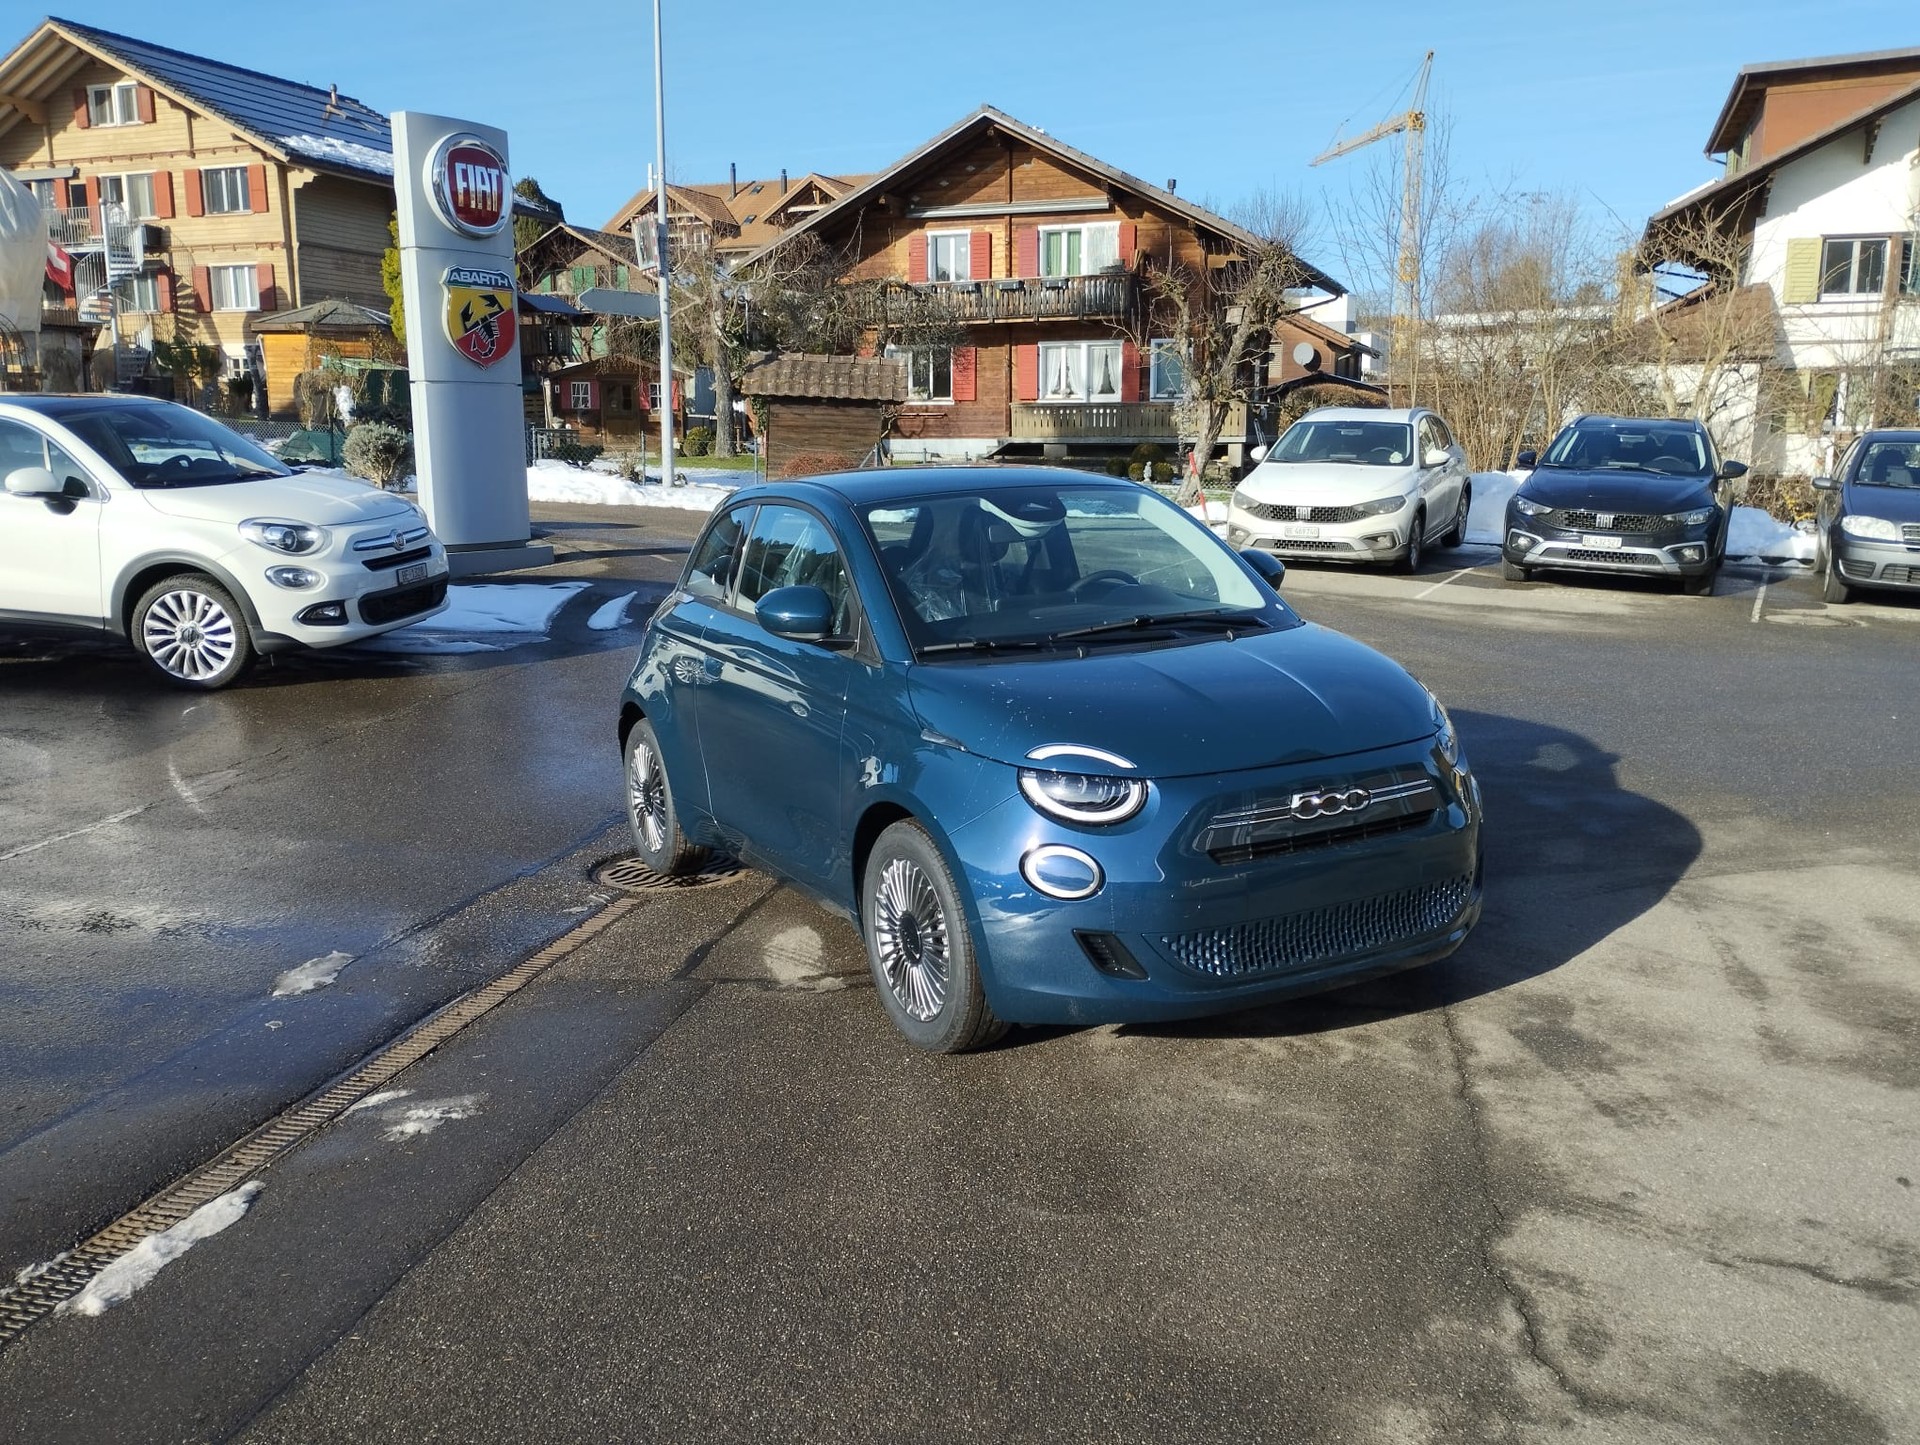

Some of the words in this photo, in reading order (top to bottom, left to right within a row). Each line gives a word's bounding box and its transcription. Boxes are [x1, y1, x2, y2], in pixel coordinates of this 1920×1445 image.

[454, 162, 500, 212] FIAT
[450, 271, 508, 287] ABARTH
[1295, 506, 1312, 519] FIAT
[1595, 514, 1616, 528] FIAT
[1291, 789, 1370, 819] 500
